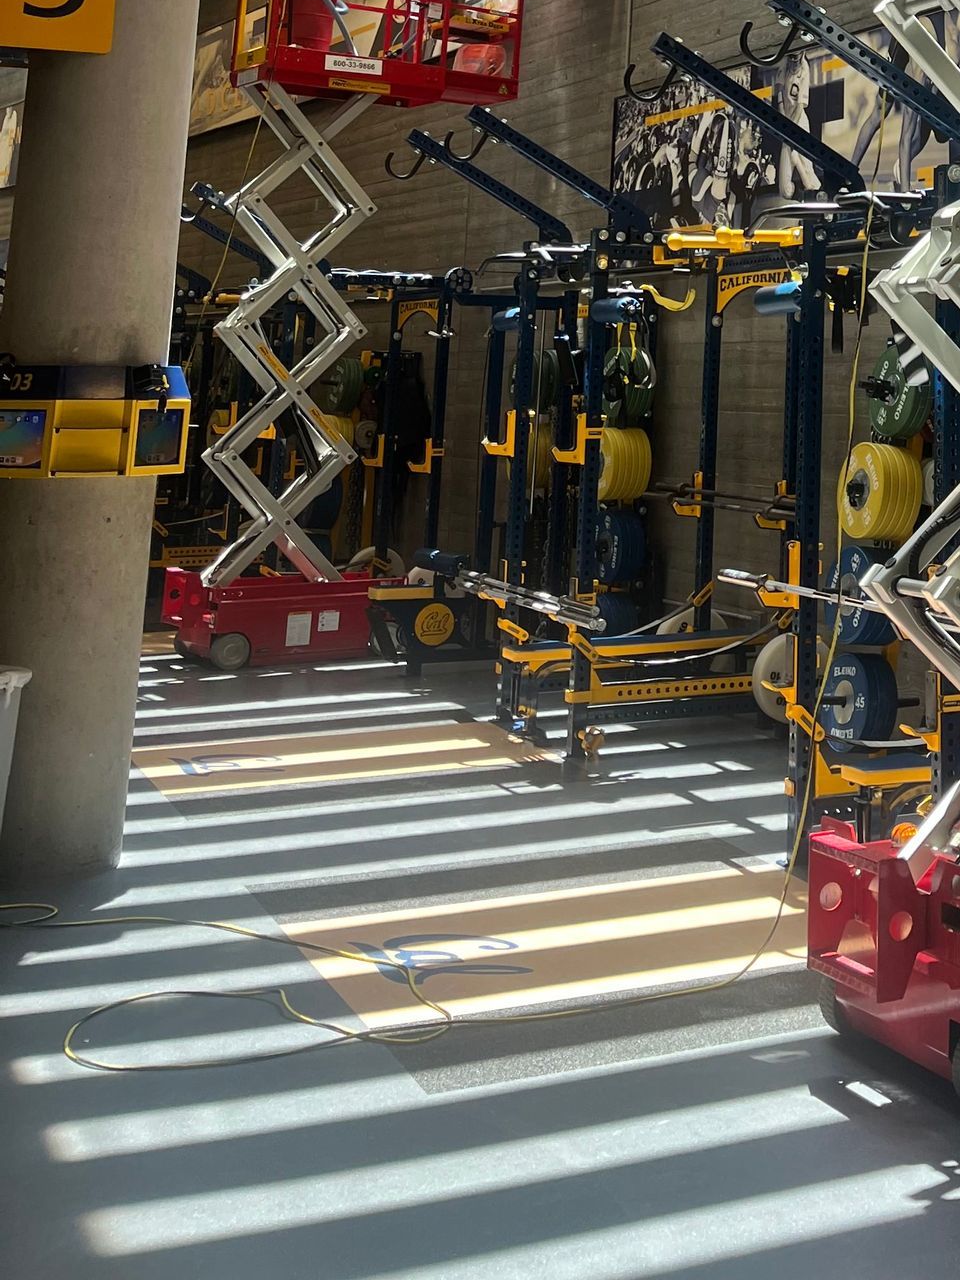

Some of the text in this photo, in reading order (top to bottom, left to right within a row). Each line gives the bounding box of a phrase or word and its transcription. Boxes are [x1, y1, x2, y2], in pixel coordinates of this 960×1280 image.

[420, 612, 449, 637] Cal
[834, 666, 856, 677] ELEIKO
[855, 697, 865, 709] 45
